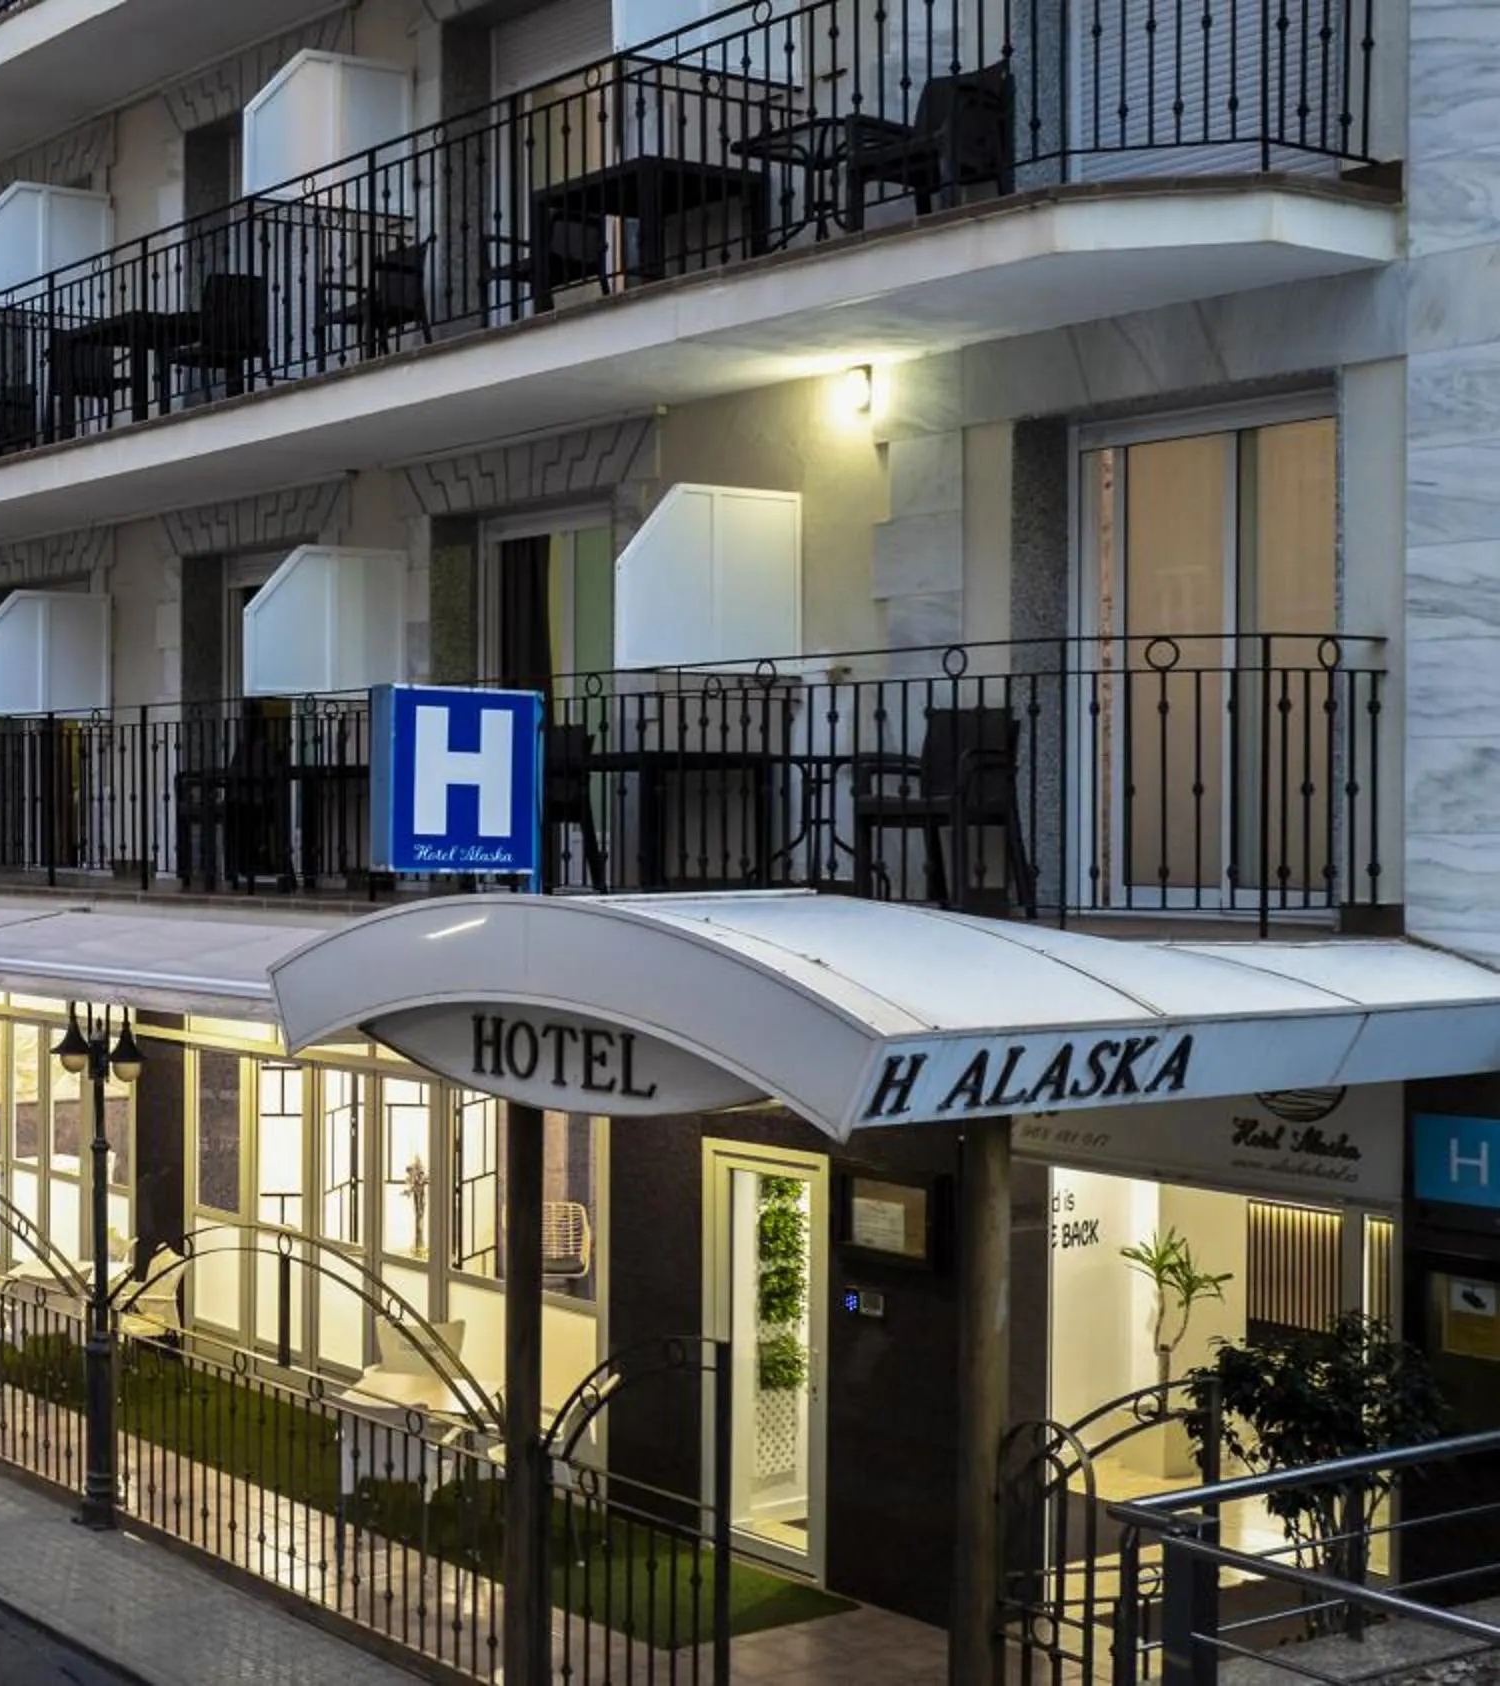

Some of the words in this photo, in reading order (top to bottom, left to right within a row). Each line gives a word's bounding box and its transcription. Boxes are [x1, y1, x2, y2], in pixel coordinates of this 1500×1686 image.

[414, 705, 514, 838] H
[413, 844, 458, 861] Hotel
[460, 845, 514, 863] Alaska
[472, 1012, 657, 1099] HOTEL
[863, 1052, 929, 1120] H
[936, 1034, 1194, 1112] ALASKA
[1232, 1116, 1285, 1150] Hotel
[1290, 1126, 1362, 1161] Alaska
[1450, 1138, 1489, 1187] H
[1063, 1188, 1075, 1212] is
[1062, 1219, 1099, 1249] BACK
